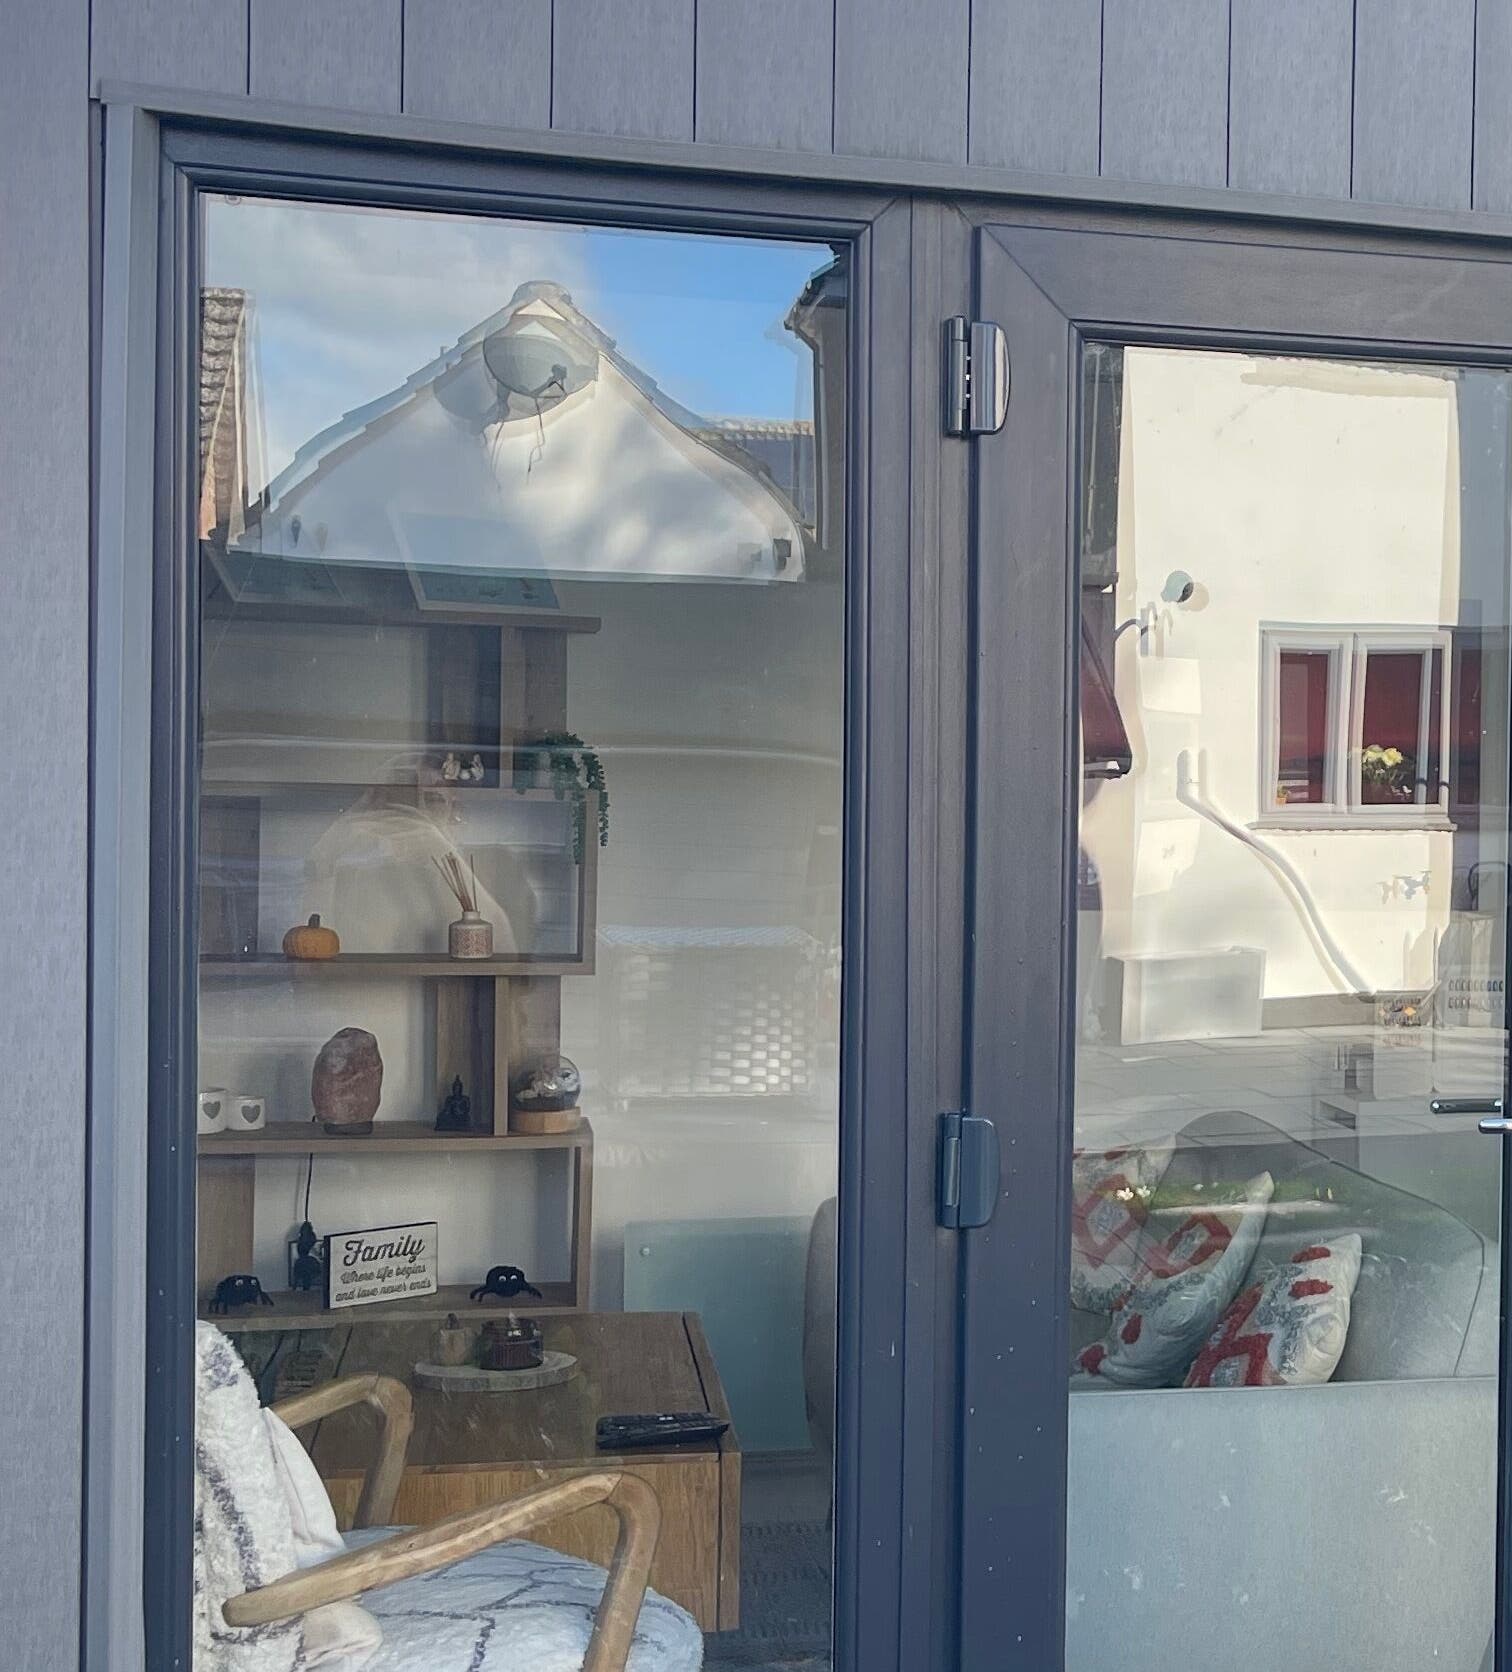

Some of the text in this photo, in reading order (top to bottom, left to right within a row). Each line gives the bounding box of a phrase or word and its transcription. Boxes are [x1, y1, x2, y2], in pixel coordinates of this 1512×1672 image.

[343, 1235, 425, 1266] Family
[341, 1264, 426, 1284] Where life begins
[335, 1279, 431, 1301] and love never ends
